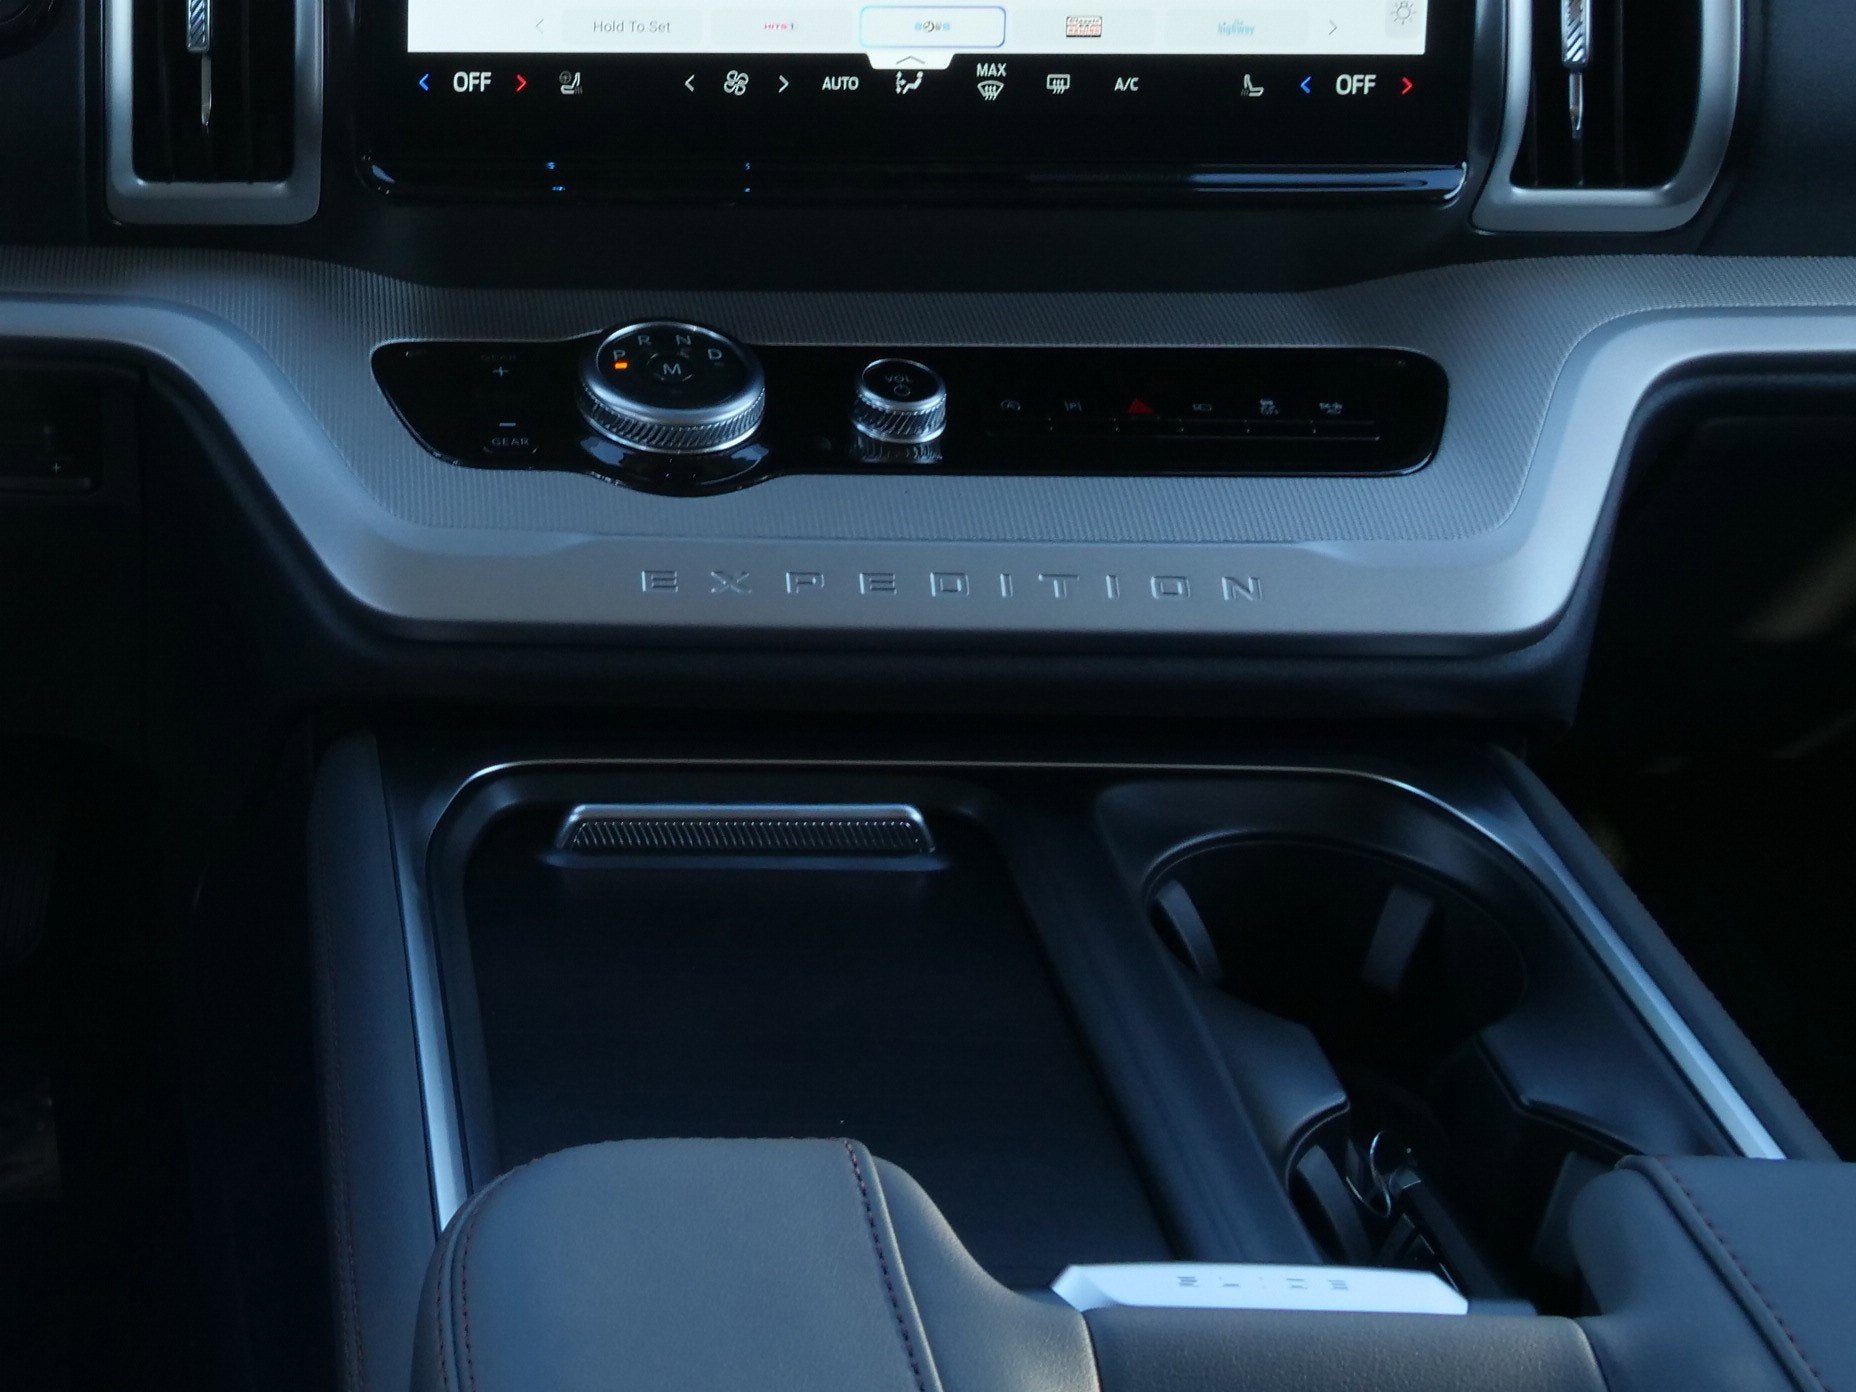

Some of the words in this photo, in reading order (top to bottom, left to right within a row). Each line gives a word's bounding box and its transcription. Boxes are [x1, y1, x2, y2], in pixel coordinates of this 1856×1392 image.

[593, 20, 624, 33] Hold
[629, 20, 645, 33] To
[649, 20, 672, 33] Set
[976, 63, 1007, 78] MAX
[453, 72, 492, 93] OFF
[822, 76, 859, 91] AUTO
[1114, 76, 1139, 92] A/C
[1335, 74, 1376, 95] OFF
[637, 335, 651, 346] R
[675, 334, 692, 346] N
[612, 349, 626, 362] P
[707, 348, 722, 360] D
[663, 363, 682, 375] M
[641, 570, 1263, 601] EXPEDITION
